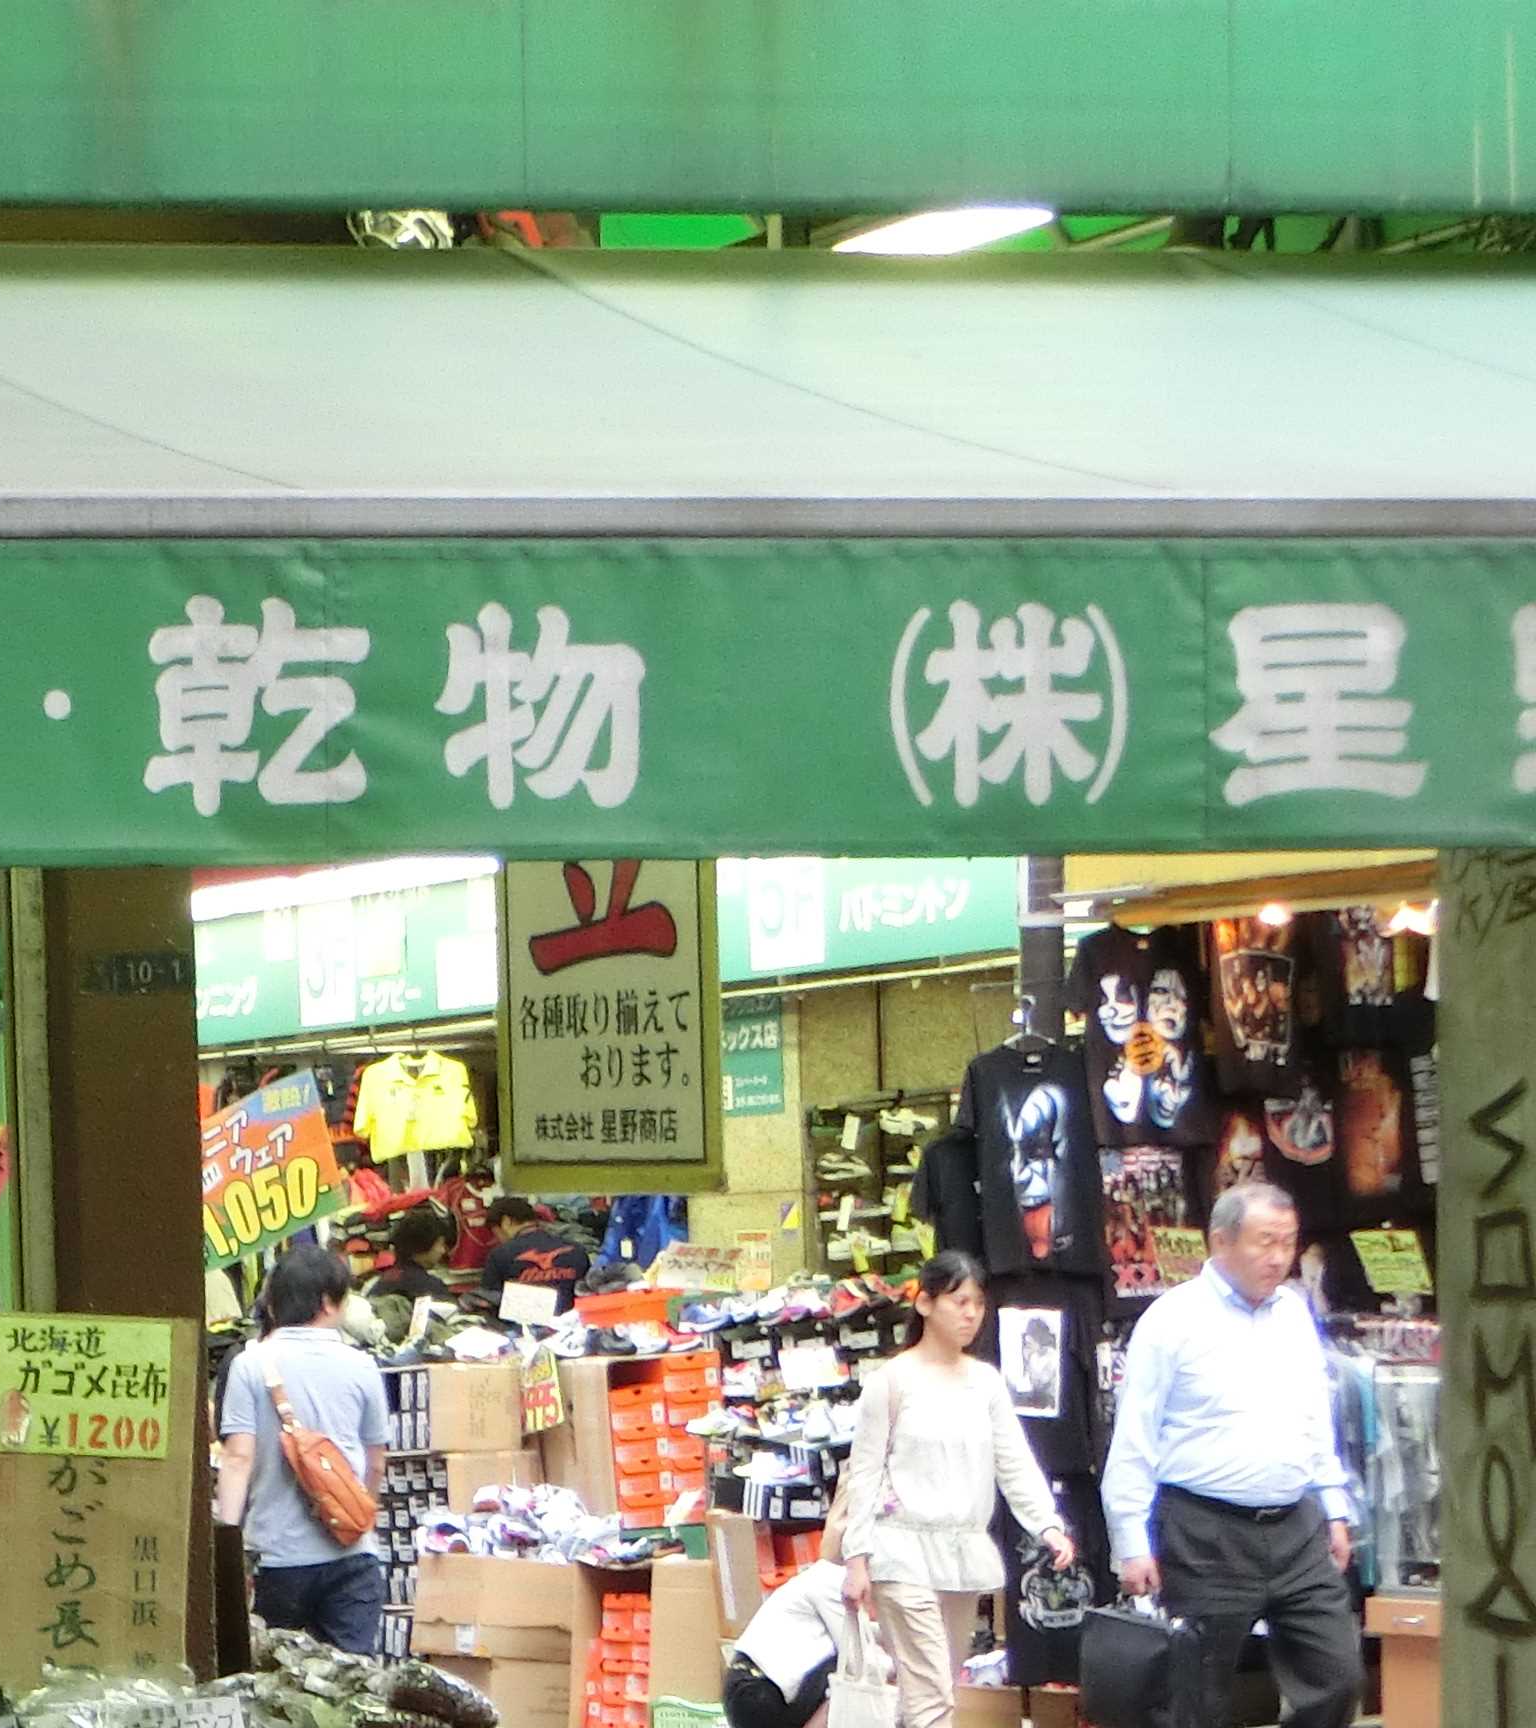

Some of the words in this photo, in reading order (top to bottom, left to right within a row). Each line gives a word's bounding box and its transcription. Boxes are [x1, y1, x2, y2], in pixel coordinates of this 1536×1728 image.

[518, 988, 691, 1042] 各種取り揃えて
[580, 1041, 691, 1089] おります。
[229, 1121, 294, 1176] ウェア
[534, 1111, 595, 1143] 株式会社
[599, 1105, 680, 1145] 星野商店
[5, 1325, 108, 1361] 北海道
[17, 1361, 169, 1407] ガゴメ昆布
